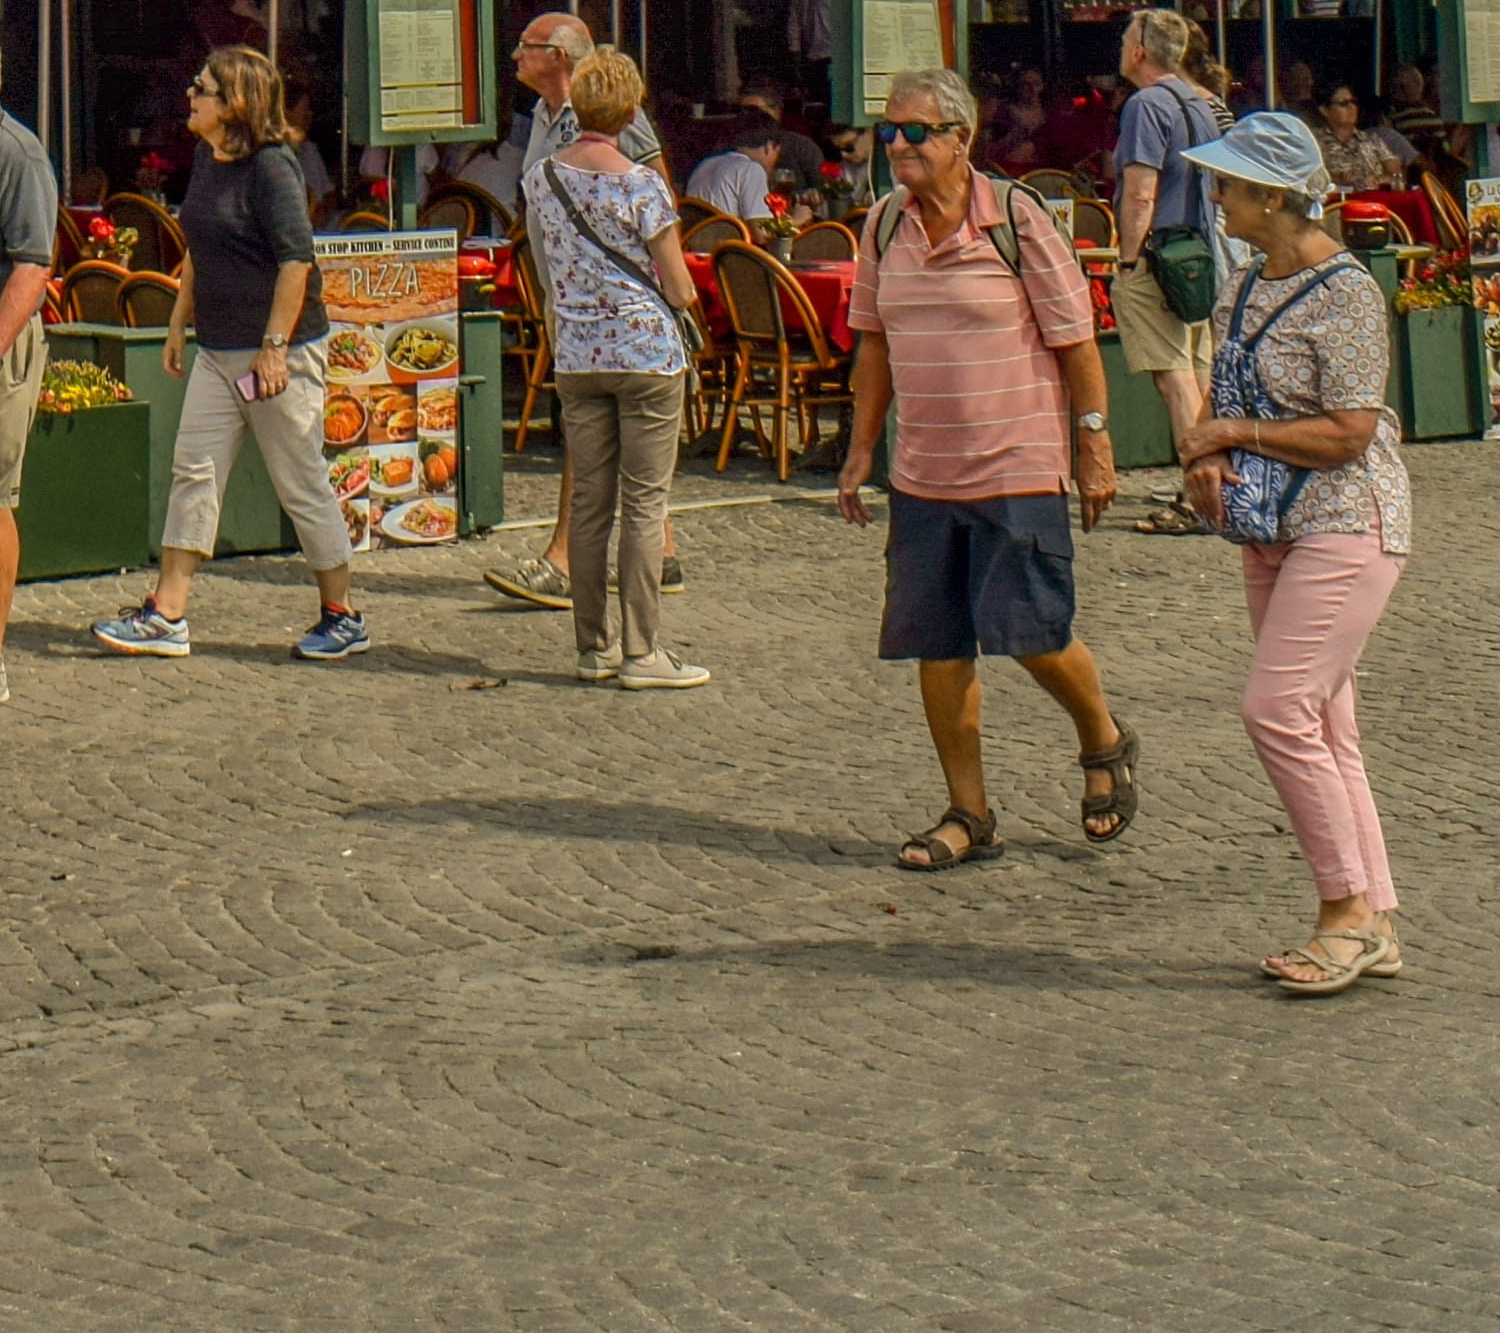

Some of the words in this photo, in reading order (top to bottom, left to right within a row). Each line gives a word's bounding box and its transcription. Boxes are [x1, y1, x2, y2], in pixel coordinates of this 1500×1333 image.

[328, 243, 349, 254] STOP
[351, 241, 384, 253] KITCHEN
[393, 238, 422, 251] SERVICE
[351, 262, 420, 298] PIZZA
